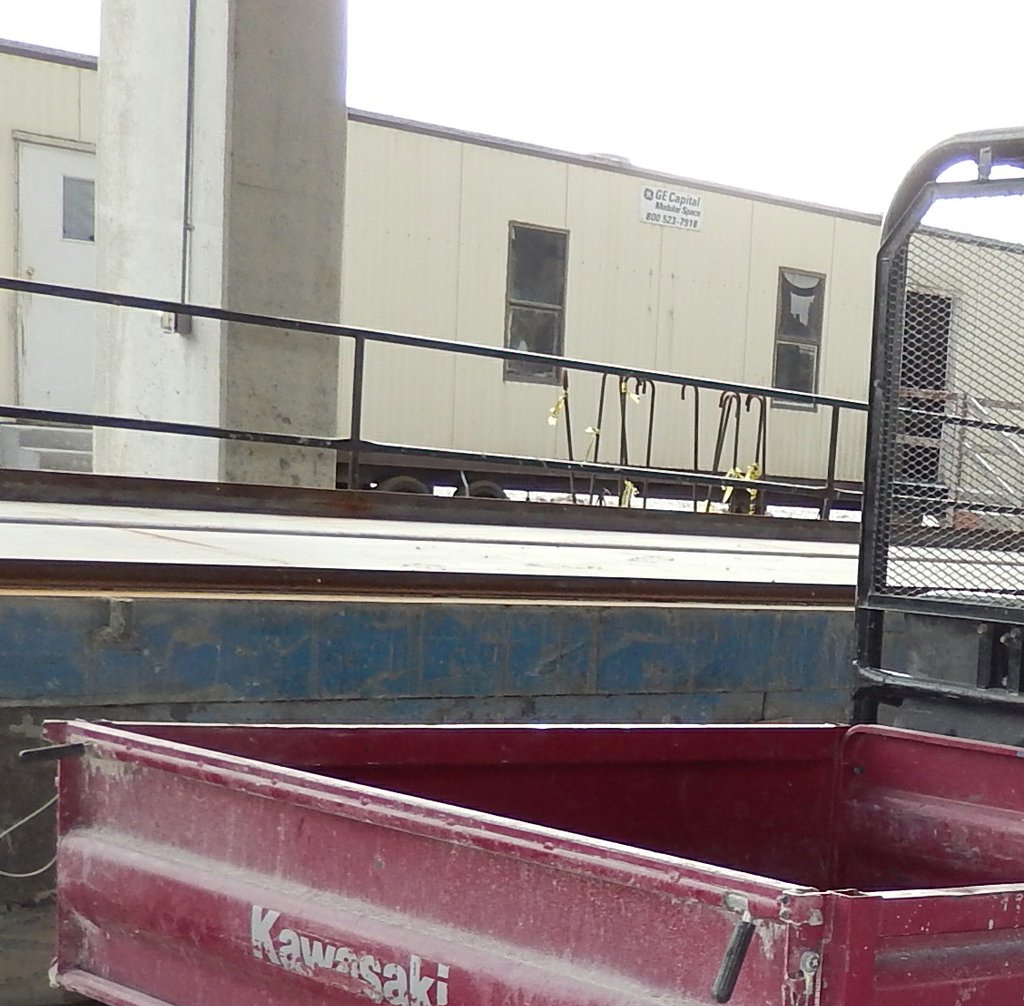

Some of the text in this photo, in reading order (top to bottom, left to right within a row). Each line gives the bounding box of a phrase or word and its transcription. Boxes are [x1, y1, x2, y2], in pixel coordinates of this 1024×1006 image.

[656, 189, 701, 207] GE Capital
[655, 201, 701, 217] Modular Space
[646, 212, 698, 228] 800 523-7918
